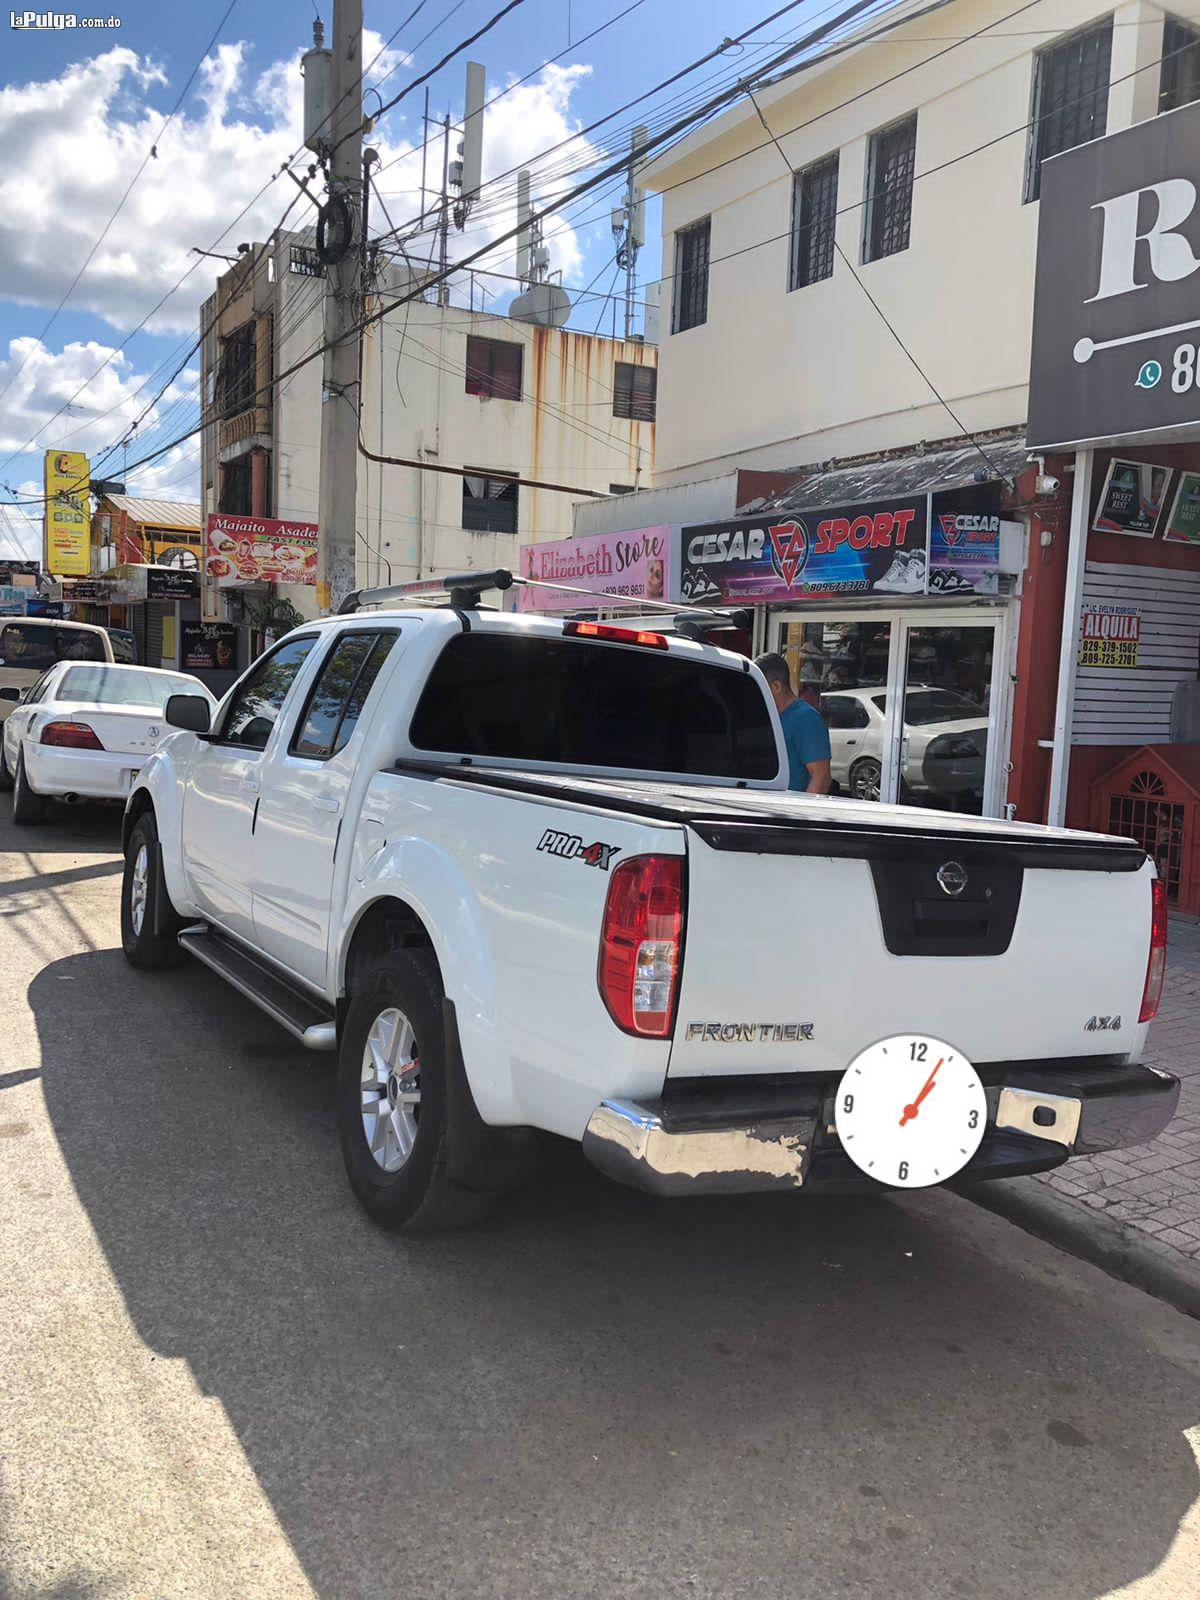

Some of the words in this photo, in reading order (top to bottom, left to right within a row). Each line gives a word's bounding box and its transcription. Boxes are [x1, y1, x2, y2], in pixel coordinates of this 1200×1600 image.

[1171, 343, 1200, 394] 8
[215, 519, 266, 534] Majaito
[687, 528, 765, 565] CESAR
[814, 509, 916, 554] SPORT
[955, 514, 1000, 532] CESAR
[540, 543, 613, 580] Elizabeth
[615, 534, 665, 573] Store
[1085, 614, 1138, 639] ALQUILA
[536, 828, 622, 871] PRO-4X
[685, 1022, 815, 1042] FRONTIER
